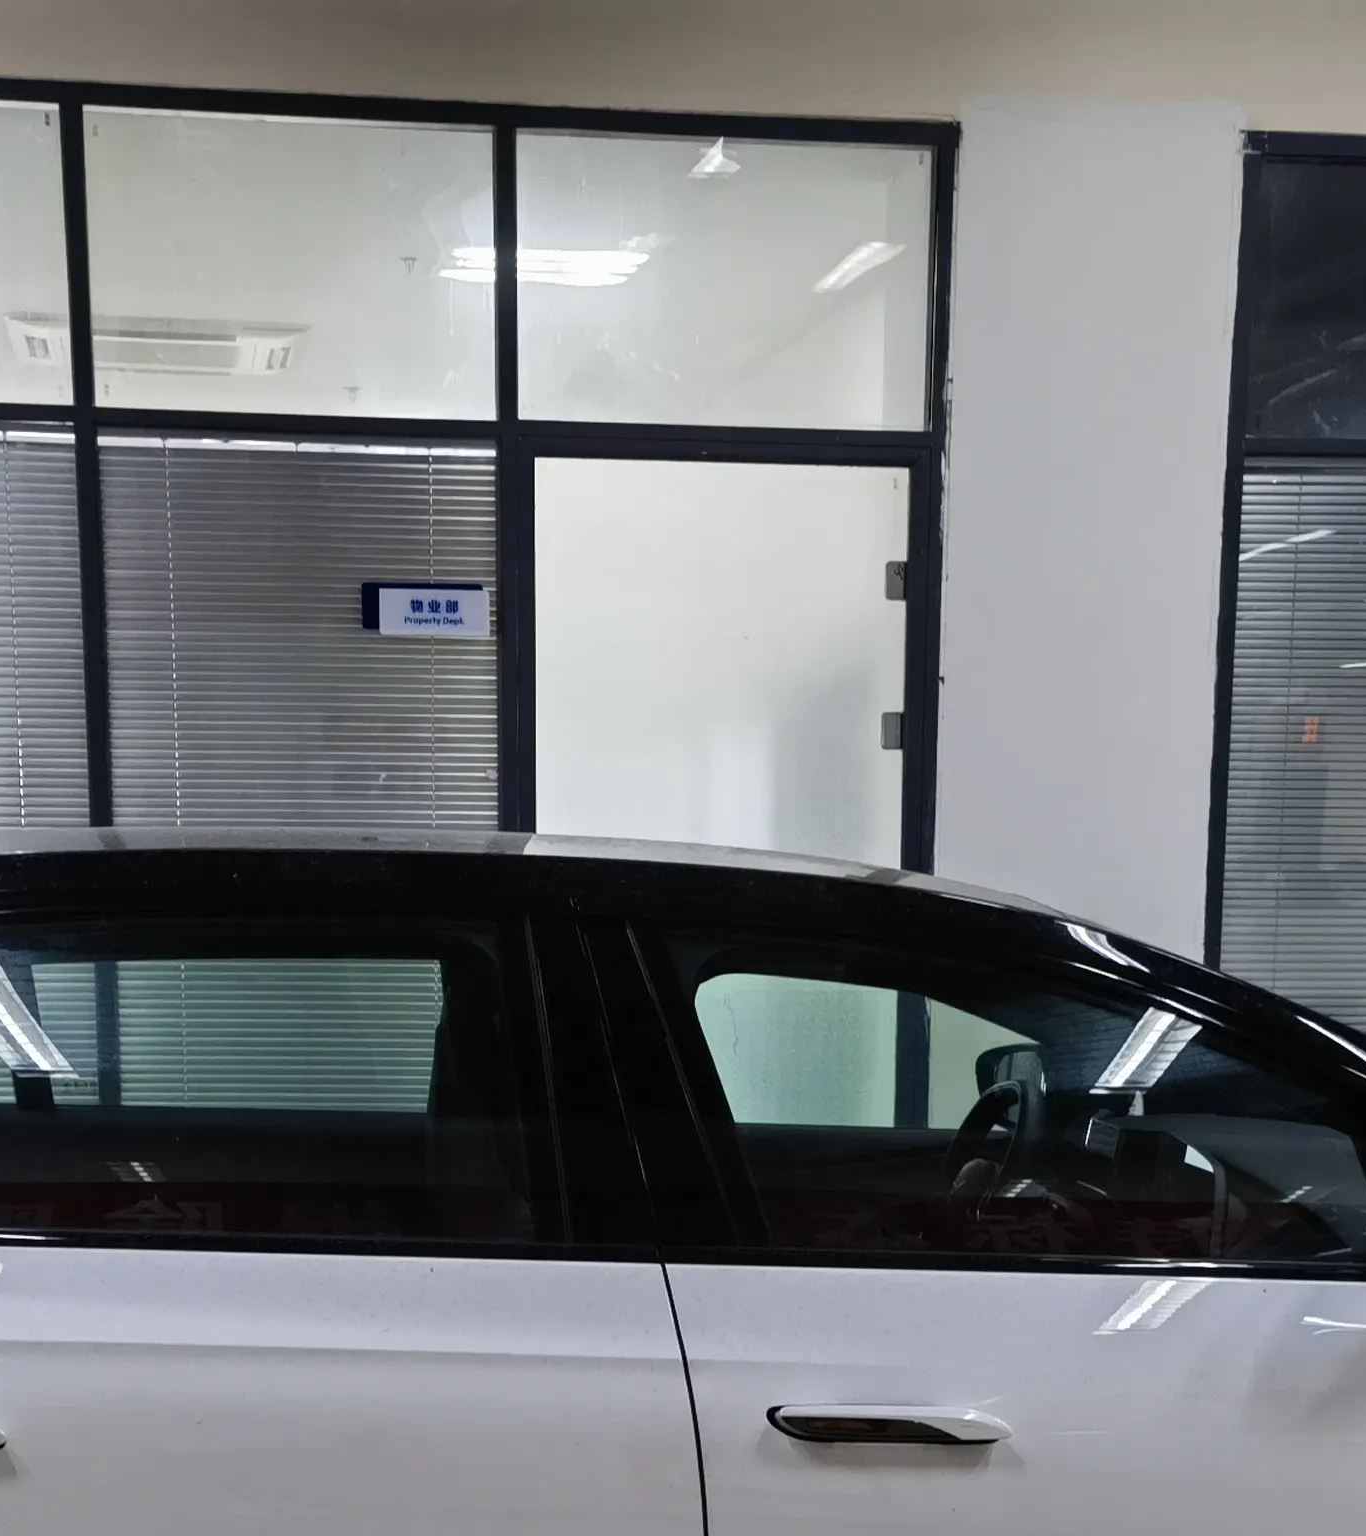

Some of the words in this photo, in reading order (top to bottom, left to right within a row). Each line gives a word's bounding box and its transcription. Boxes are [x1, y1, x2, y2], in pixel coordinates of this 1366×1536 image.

[410, 599, 459, 614] 物业部
[404, 616, 441, 626] Property
